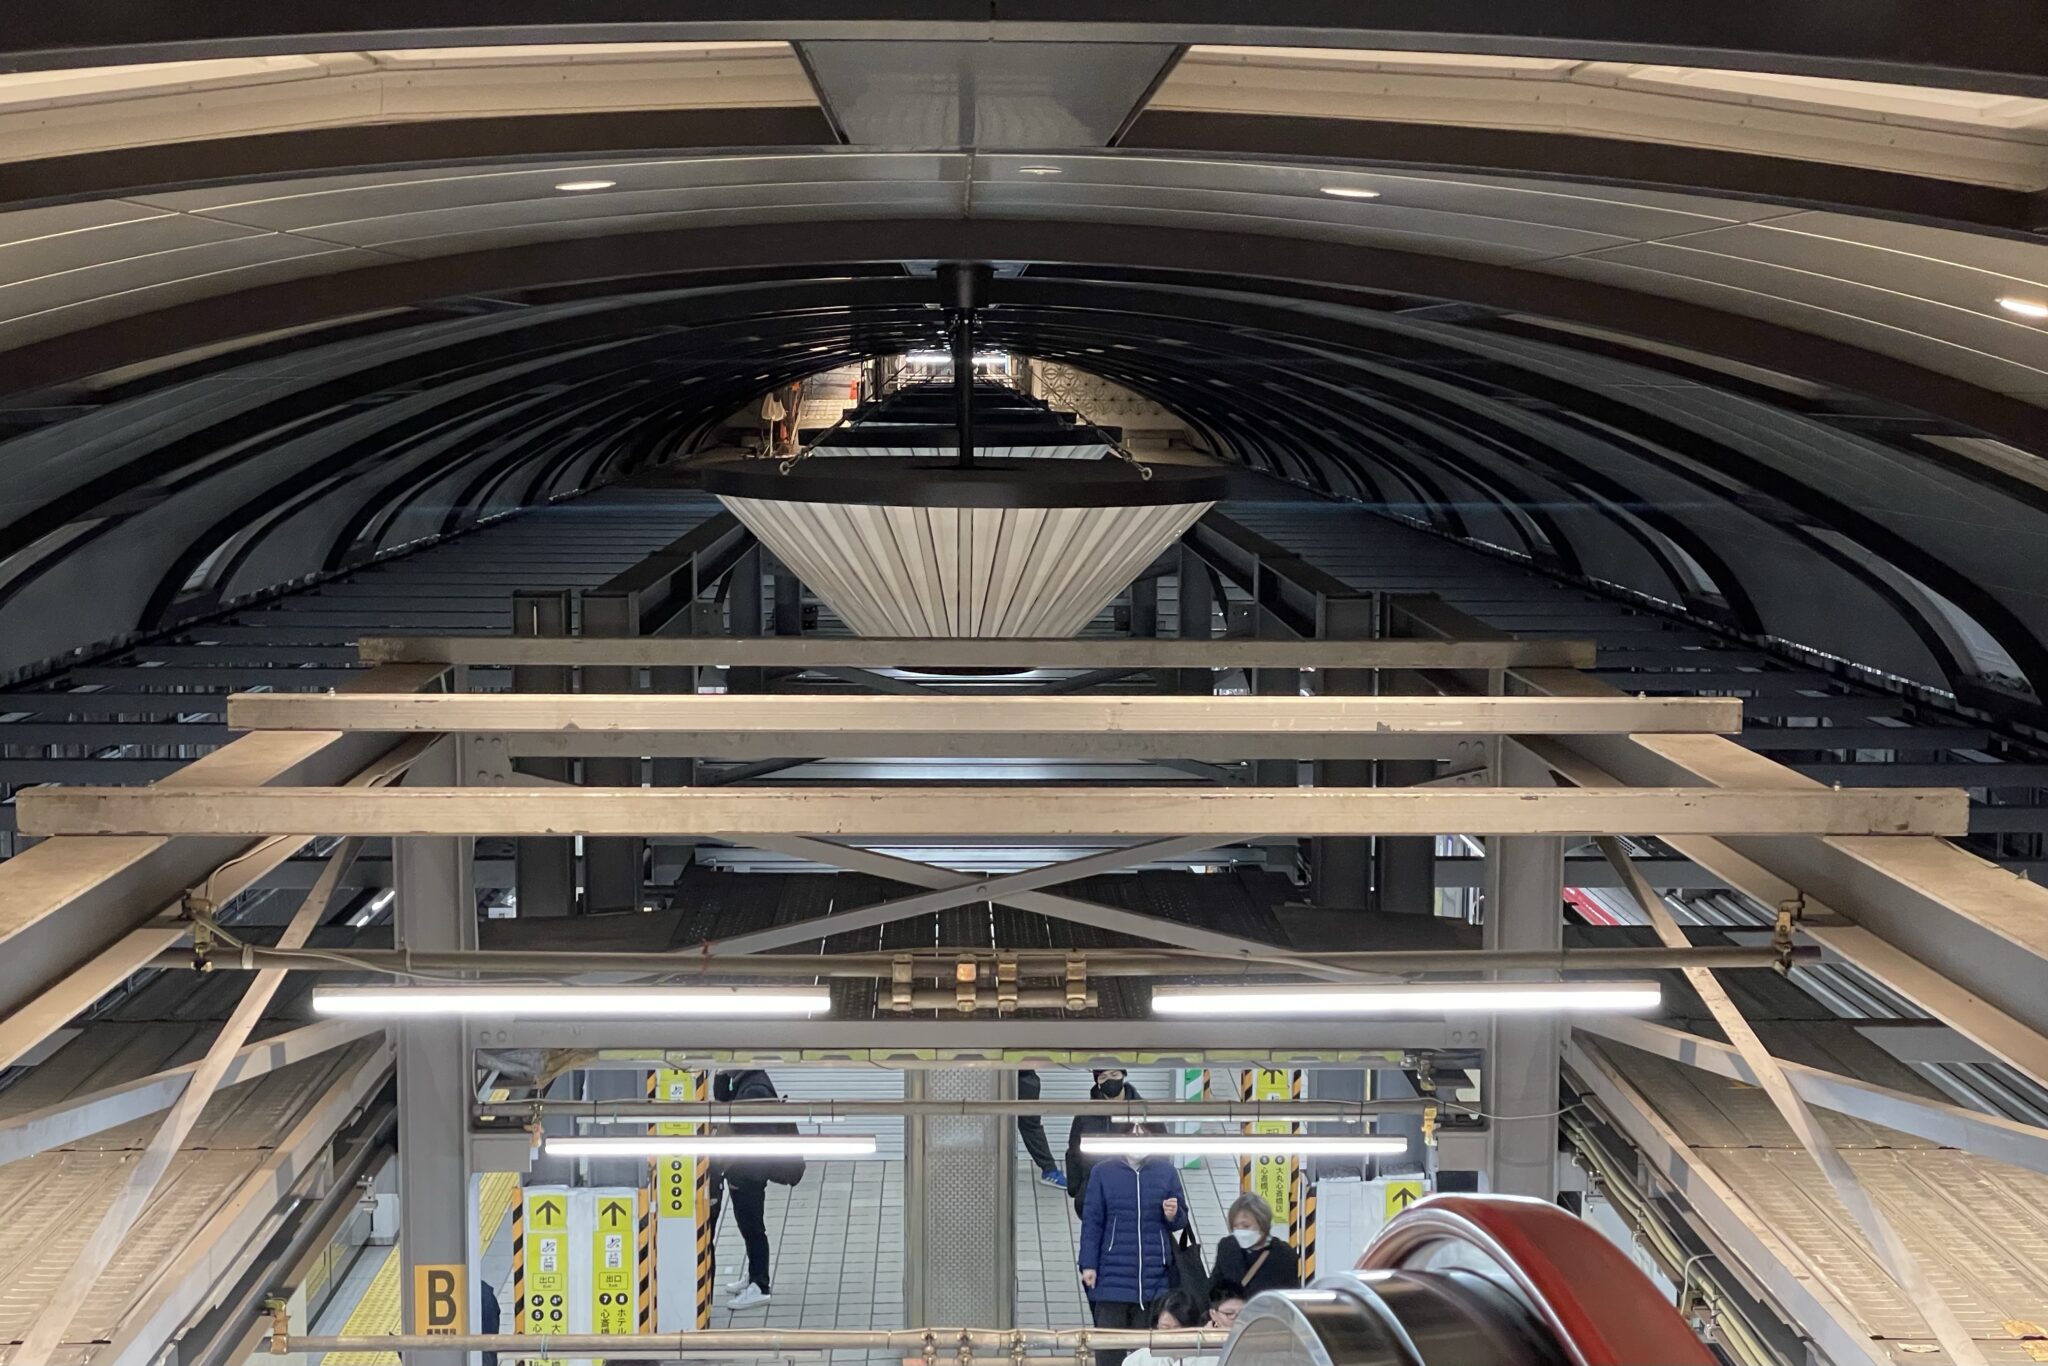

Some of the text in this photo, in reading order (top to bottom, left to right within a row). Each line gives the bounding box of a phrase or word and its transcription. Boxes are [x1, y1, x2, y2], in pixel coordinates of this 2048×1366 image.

[539, 1276, 555, 1284] 出口
[606, 1275, 622, 1283] 出口
[428, 1270, 456, 1326] B
